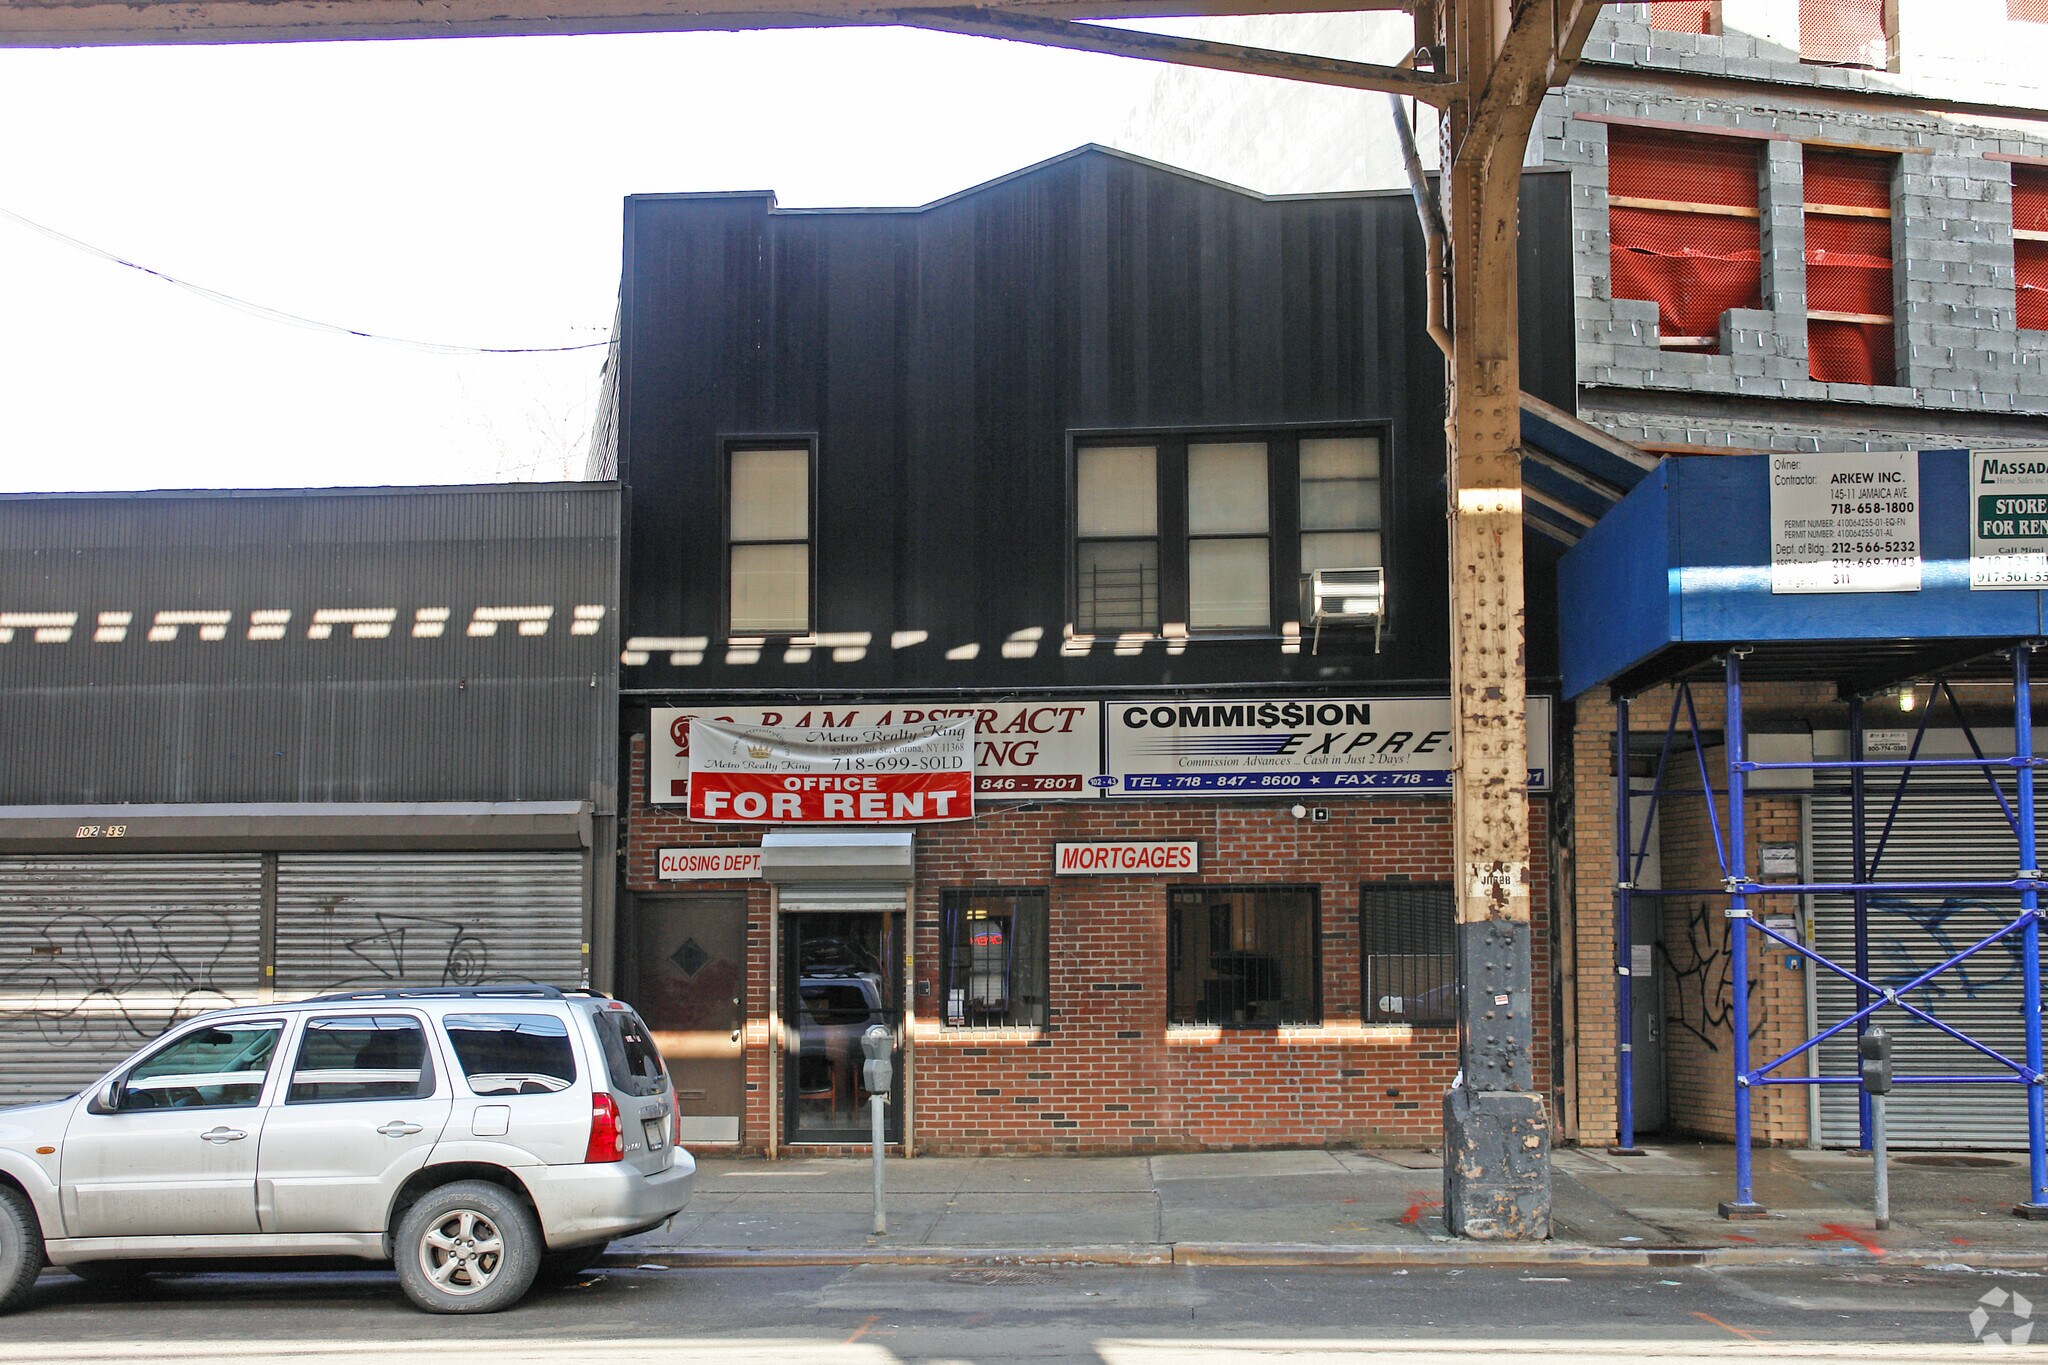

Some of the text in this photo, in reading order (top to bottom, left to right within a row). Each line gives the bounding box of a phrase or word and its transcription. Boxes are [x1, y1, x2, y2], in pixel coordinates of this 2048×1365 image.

[1774, 459, 1801, 471] Owner:
[1980, 459, 2048, 479] MASSAD
[1774, 472, 1906, 486] Contractor: ARKEW INC.
[1830, 488, 1910, 500] 145-11 JAMAICA AVE.
[1831, 502, 1914, 514] 718-658-1800
[1995, 498, 2048, 515] STORE
[1784, 520, 1806, 528] PERMIT
[1808, 520, 1835, 528] NUMBER:
[1983, 519, 2048, 536] FOR REN
[1784, 530, 1806, 538] PERMIT
[1808, 530, 1835, 538] NUMBER:
[1776, 544, 1796, 556] Dept.
[1798, 543, 1806, 554] of
[1831, 542, 1915, 554] 212-566-5232
[1832, 574, 1851, 585] 311
[806, 724, 966, 743] Metro Realty King
[893, 744, 924, 754] Corona,
[926, 744, 939, 753] NY
[942, 743, 965, 753] 11368
[704, 759, 811, 772] Metro Realty King
[832, 755, 964, 771] 718-699-SOLD
[1178, 756, 1239, 768] Commission
[1243, 756, 1291, 766] Advances
[1303, 755, 1329, 766] Cash
[1331, 755, 1341, 765] in
[1345, 754, 1365, 765] Just
[1369, 754, 1375, 765] 2
[783, 776, 878, 791] OFFICE
[980, 778, 1016, 790] 846
[1033, 777, 1077, 789] 7801
[1216, 776, 1247, 786] 847
[1261, 775, 1301, 786] 8600
[1334, 774, 1376, 785] FAX
[704, 790, 957, 819] FOR RENT
[661, 854, 761, 872] CLOSING DEPT.
[1061, 846, 1192, 869] MORTGAGES
